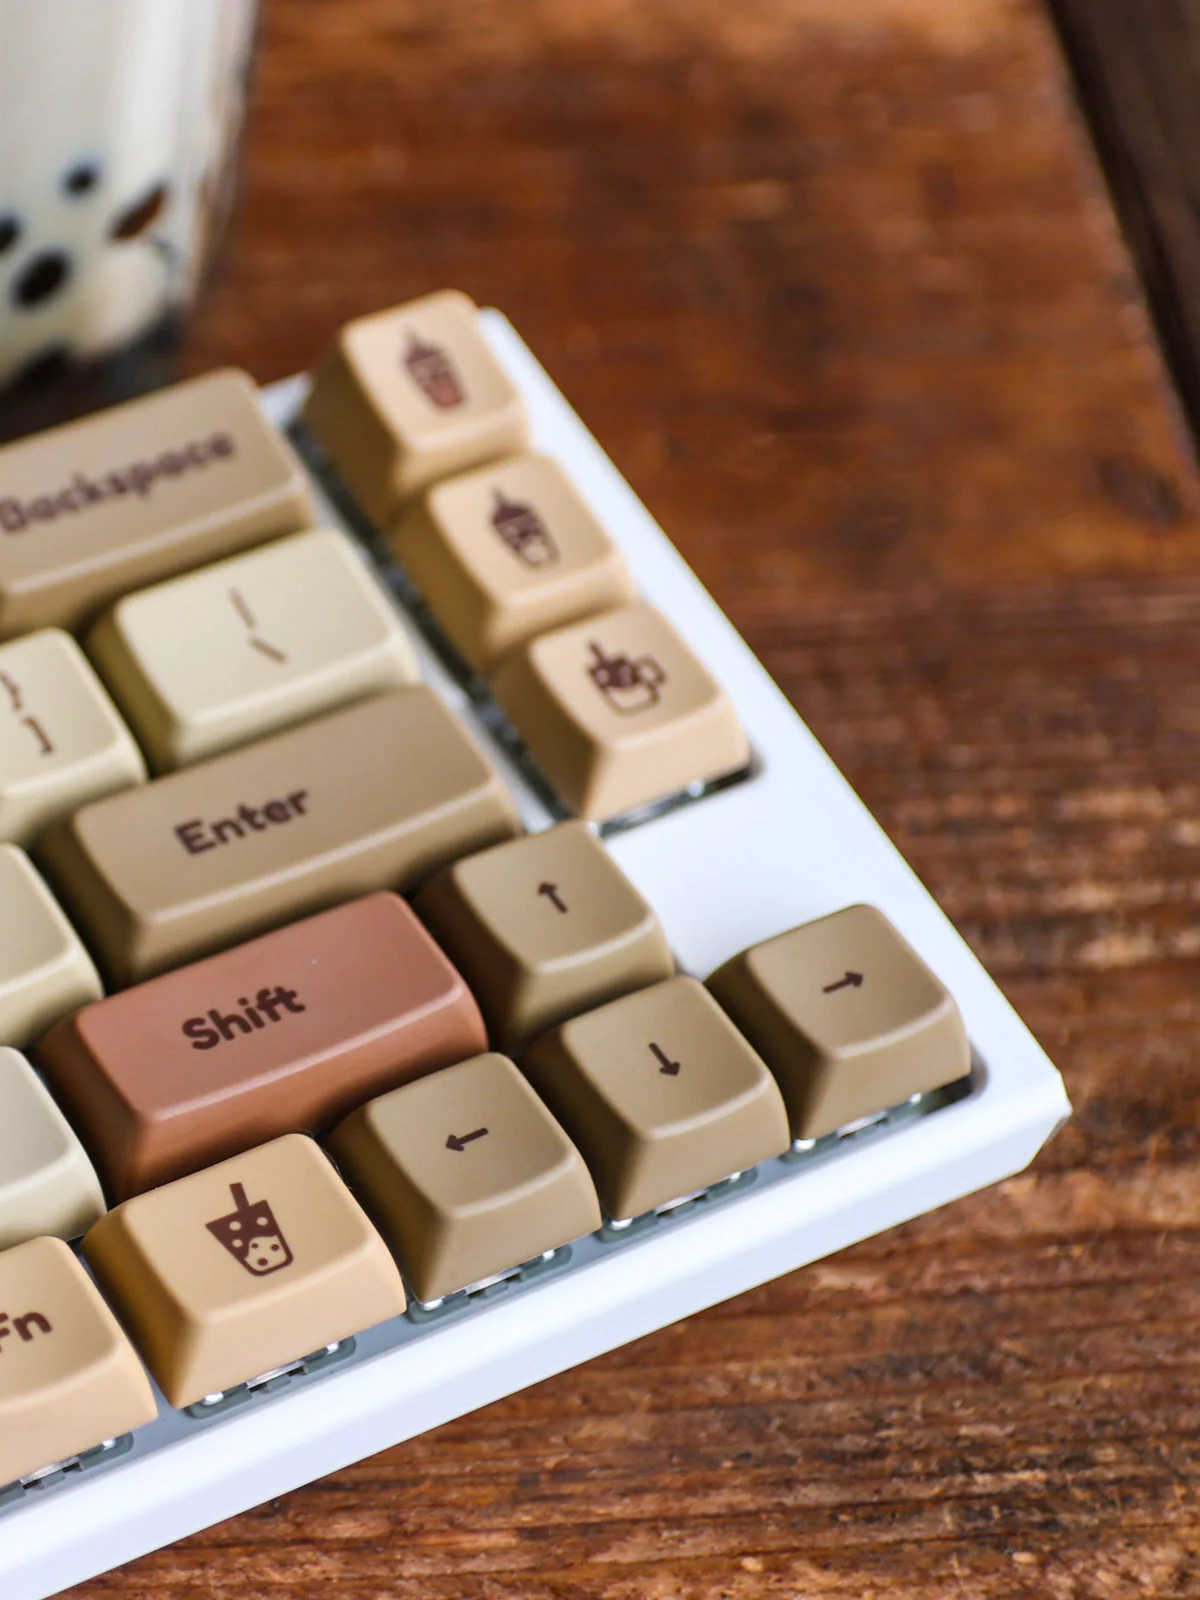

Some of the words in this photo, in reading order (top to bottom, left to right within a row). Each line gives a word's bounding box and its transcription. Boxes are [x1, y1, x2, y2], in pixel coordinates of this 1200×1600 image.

[23, 717, 54, 755] ]
[175, 791, 307, 854] Enter
[182, 986, 305, 1050] Shift
